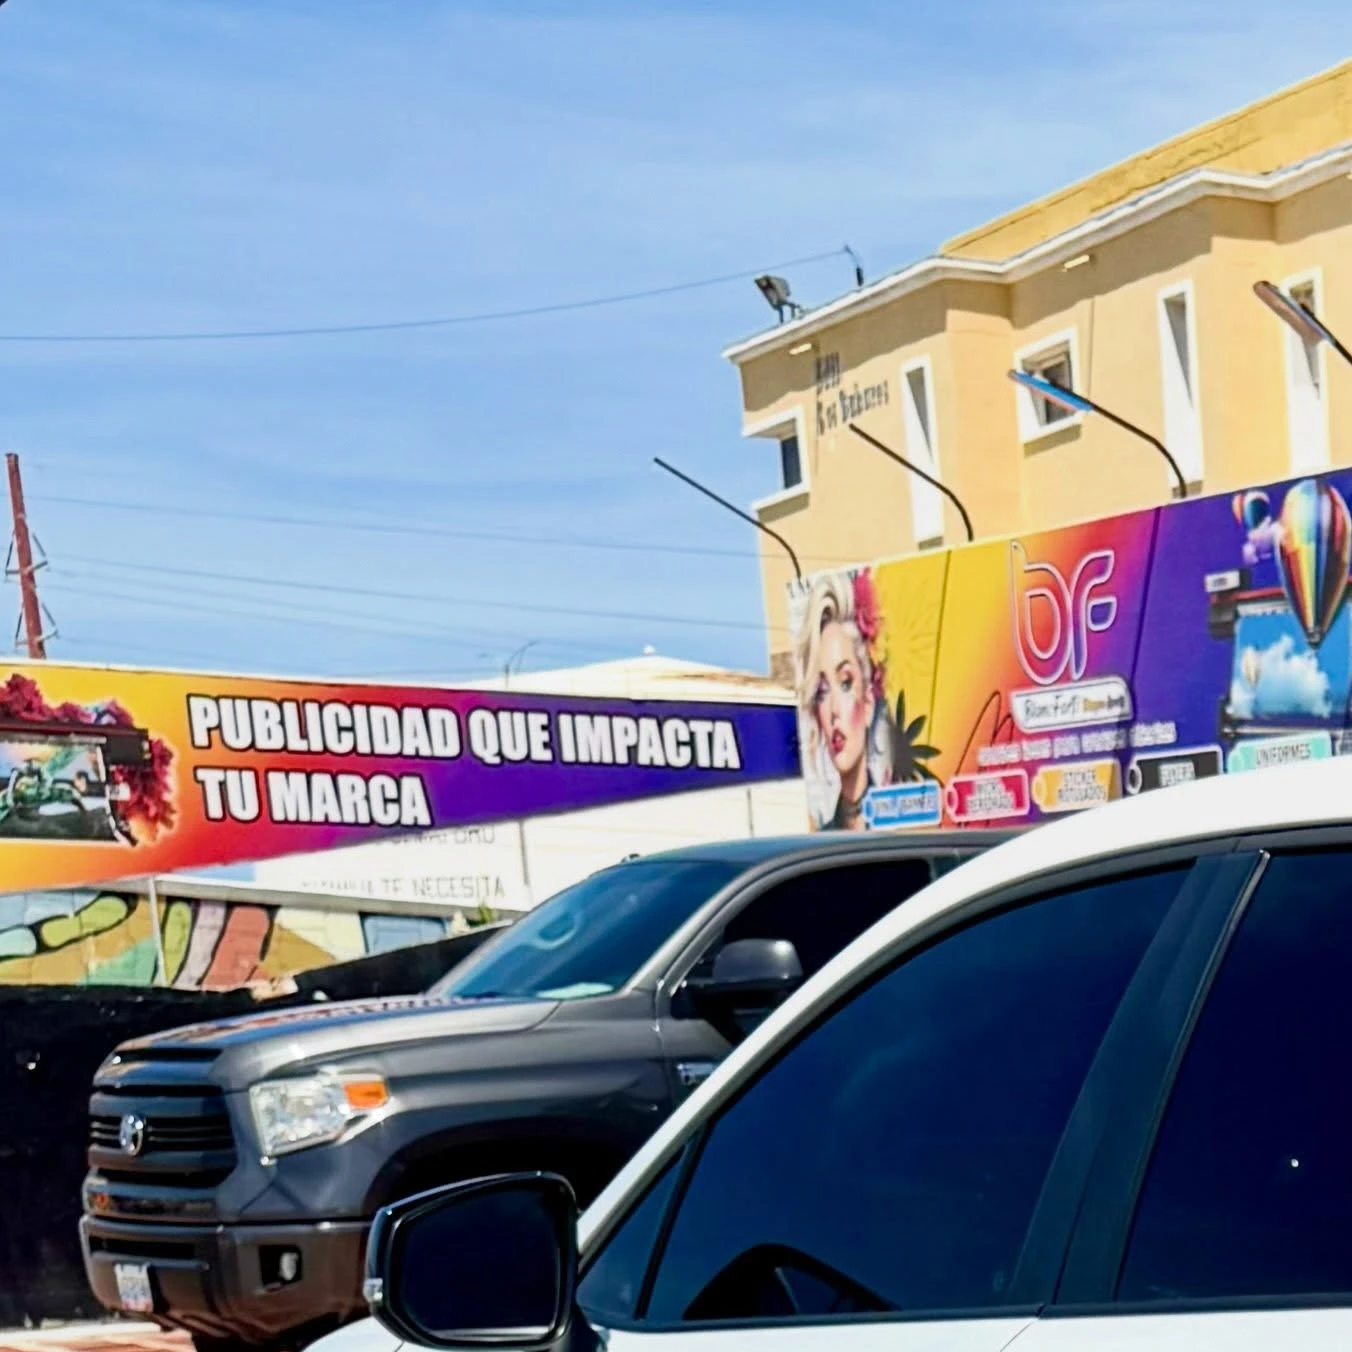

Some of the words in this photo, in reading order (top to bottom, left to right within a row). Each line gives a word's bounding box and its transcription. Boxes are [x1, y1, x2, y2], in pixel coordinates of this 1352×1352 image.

[187, 694, 463, 760] PUBLICIDAD
[467, 707, 553, 766] QUE
[558, 712, 742, 770] IMPACTA
[194, 767, 260, 822] TU
[265, 769, 433, 827] MARCA
